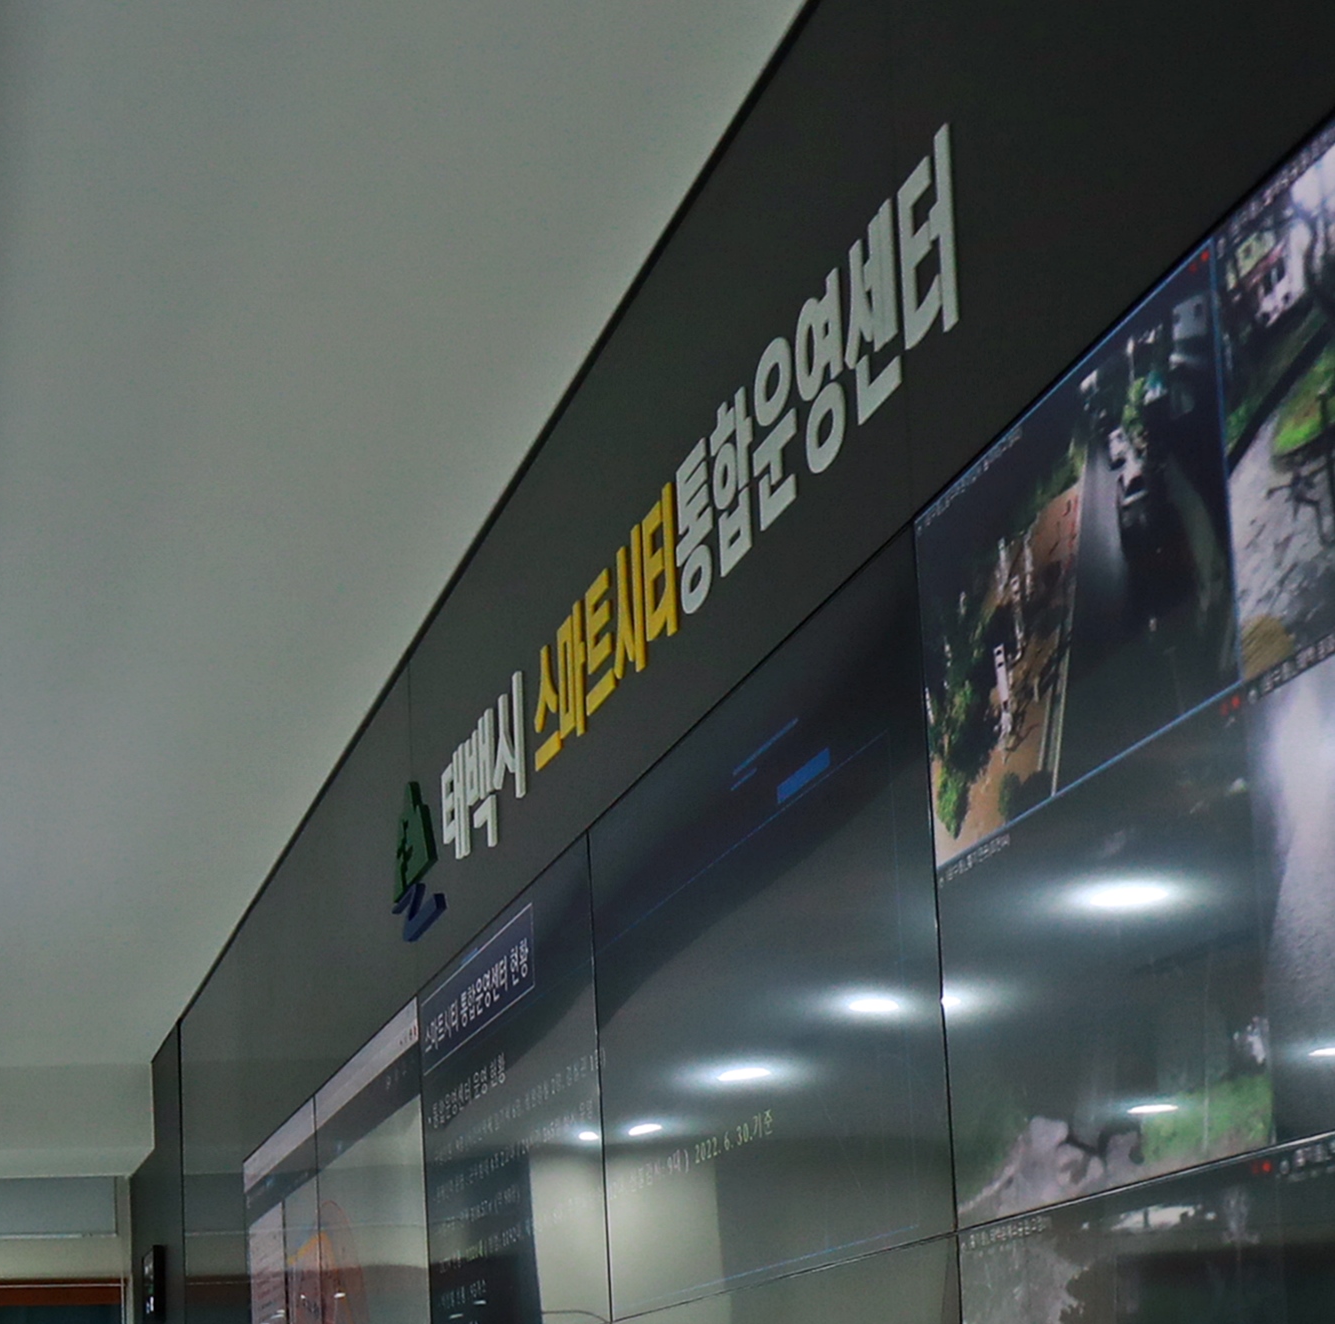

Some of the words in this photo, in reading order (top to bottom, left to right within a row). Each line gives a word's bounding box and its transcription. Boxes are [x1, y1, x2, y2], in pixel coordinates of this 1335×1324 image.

[441, 671, 526, 859] 태백시
[533, 482, 680, 773] 스마트시티
[676, 123, 959, 615] 통합운영센터
[459, 954, 508, 1027] 통합운영센터
[509, 938, 529, 986] 현황
